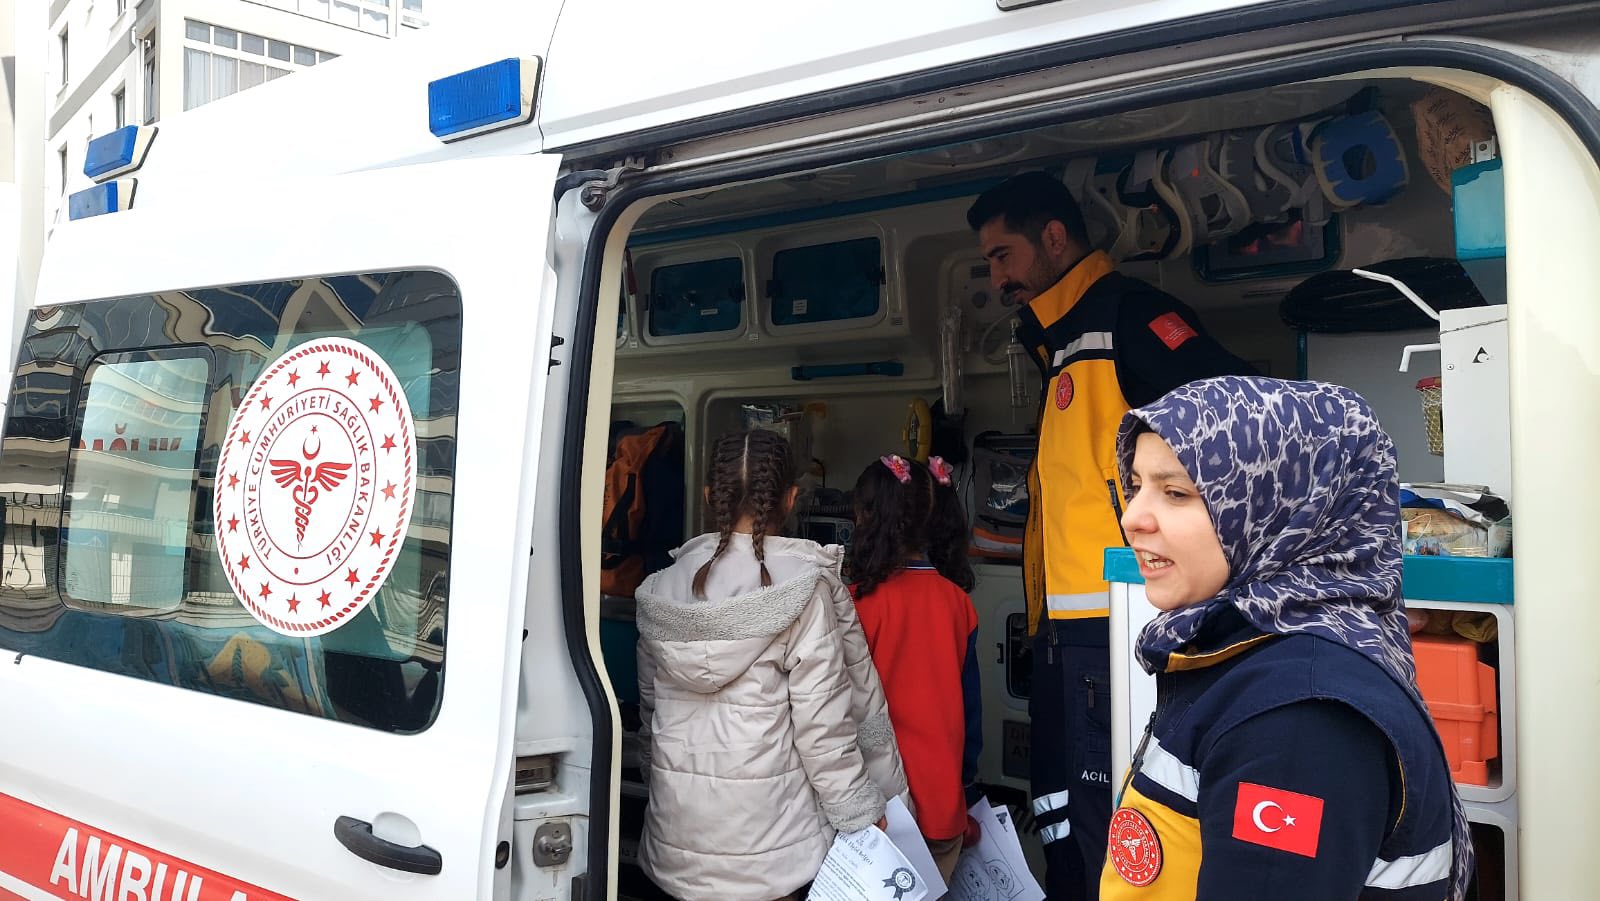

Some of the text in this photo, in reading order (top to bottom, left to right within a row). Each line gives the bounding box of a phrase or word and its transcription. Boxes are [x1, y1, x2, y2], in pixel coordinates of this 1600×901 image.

[251, 393, 331, 475] CUMHURİYETİ
[332, 401, 369, 456] SAĞLIK
[326, 462, 370, 566] BAKANLIĞI
[50, 827, 248, 901] AMBU
